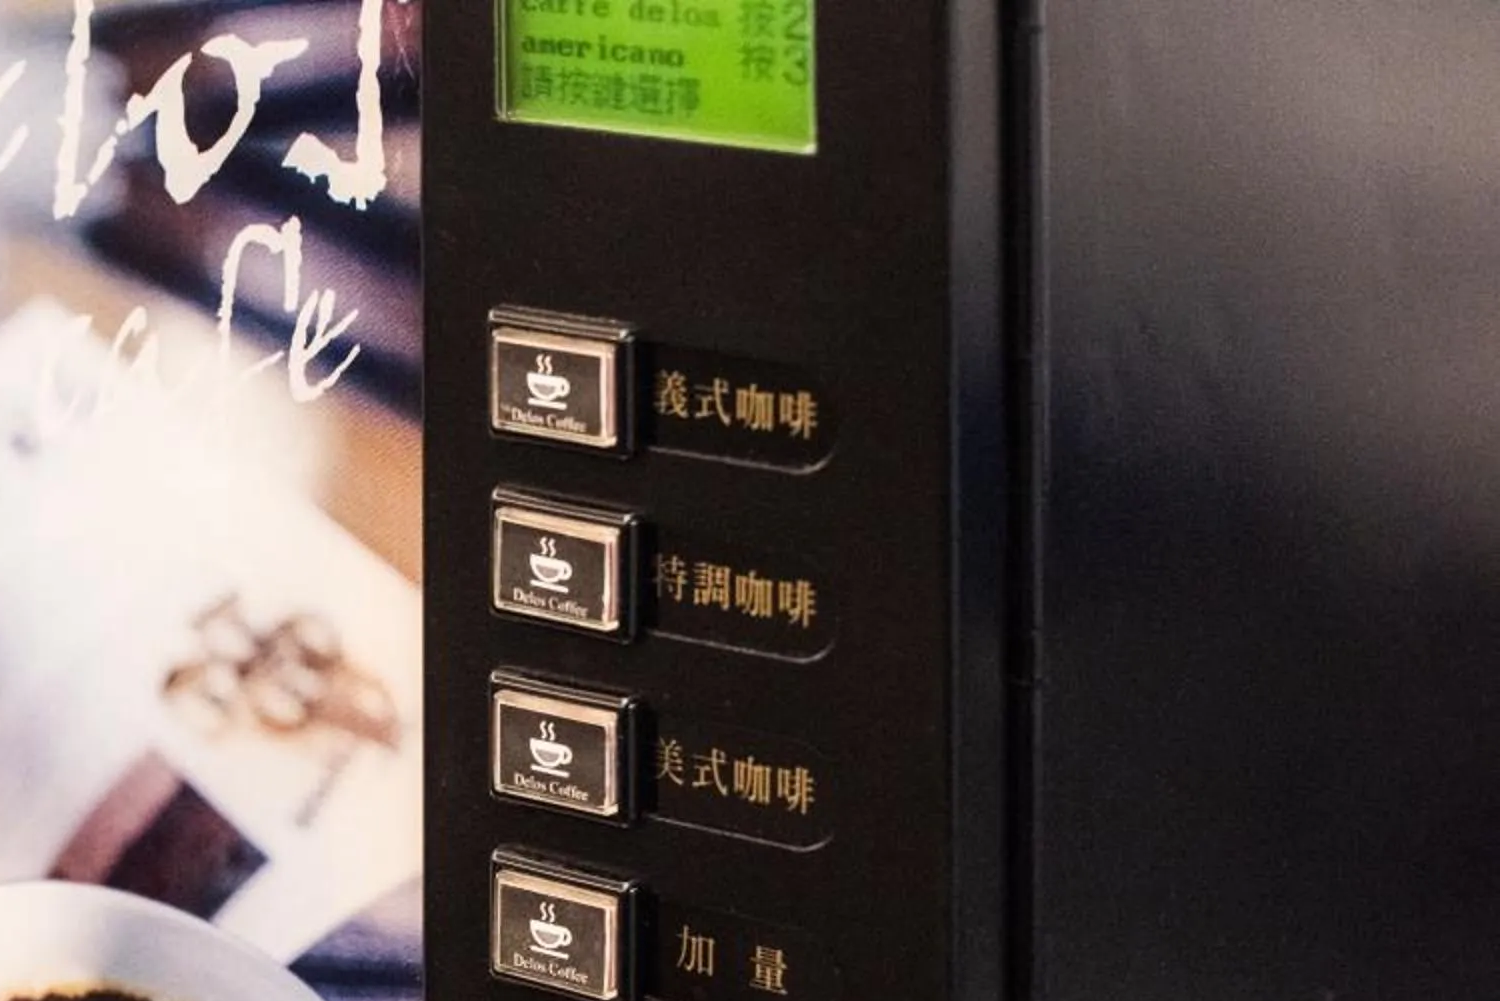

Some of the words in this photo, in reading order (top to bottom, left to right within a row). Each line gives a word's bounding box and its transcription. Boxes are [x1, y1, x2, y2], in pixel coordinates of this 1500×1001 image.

[521, 35, 685, 68] americano
[655, 370, 818, 440] 義式咖啡
[546, 414, 587, 433] Coffee
[513, 587, 547, 608] Delos
[549, 597, 589, 618] Coffee
[654, 553, 817, 629] 特調咖啡
[513, 773, 548, 791] Delos
[549, 780, 589, 801] Coffee
[656, 738, 815, 814] 美式咖啡
[513, 952, 548, 974] Delos
[549, 962, 589, 985] Coffee
